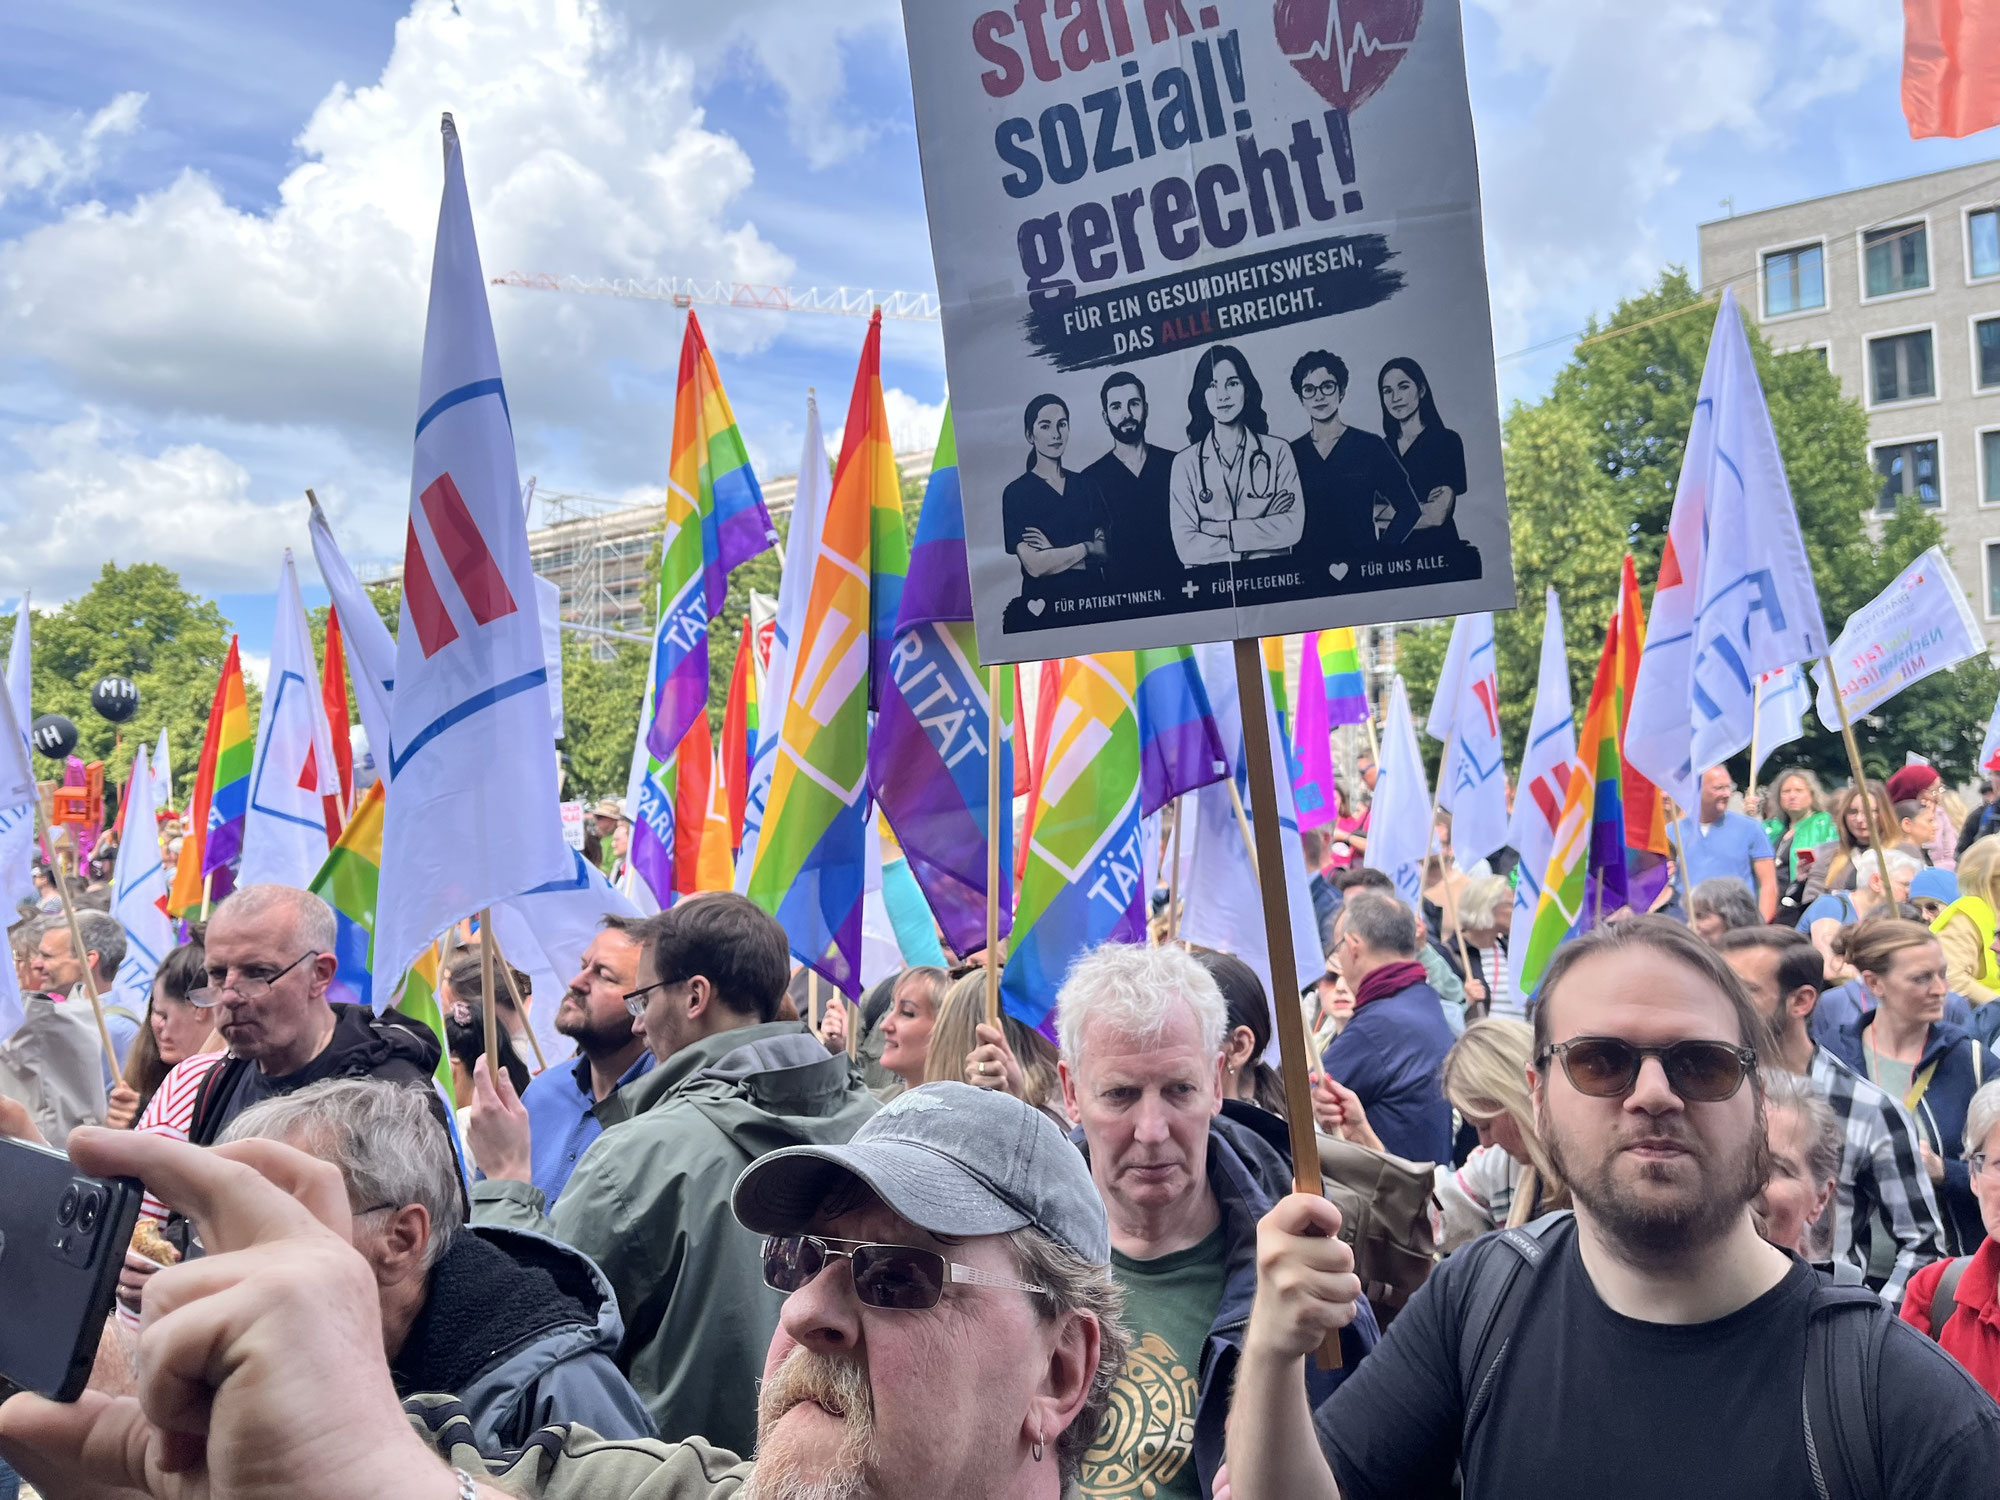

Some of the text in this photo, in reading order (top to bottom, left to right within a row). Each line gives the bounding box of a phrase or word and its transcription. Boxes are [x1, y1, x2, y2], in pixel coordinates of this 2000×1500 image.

[972, 0, 1220, 98] star
[995, 28, 1253, 199] sozial!
[1016, 109, 1364, 313] gerecht!
[1063, 243, 1364, 335] FÜR EIN GESUNDHEITSWESEN,
[1113, 287, 1323, 355] DAS ALLE ERREICHT.
[1054, 598, 1075, 613] FÜR
[1211, 572, 1305, 594] FÜR PFLEGENDE.
[1361, 555, 1449, 577] FÜR UNS ALLE.
